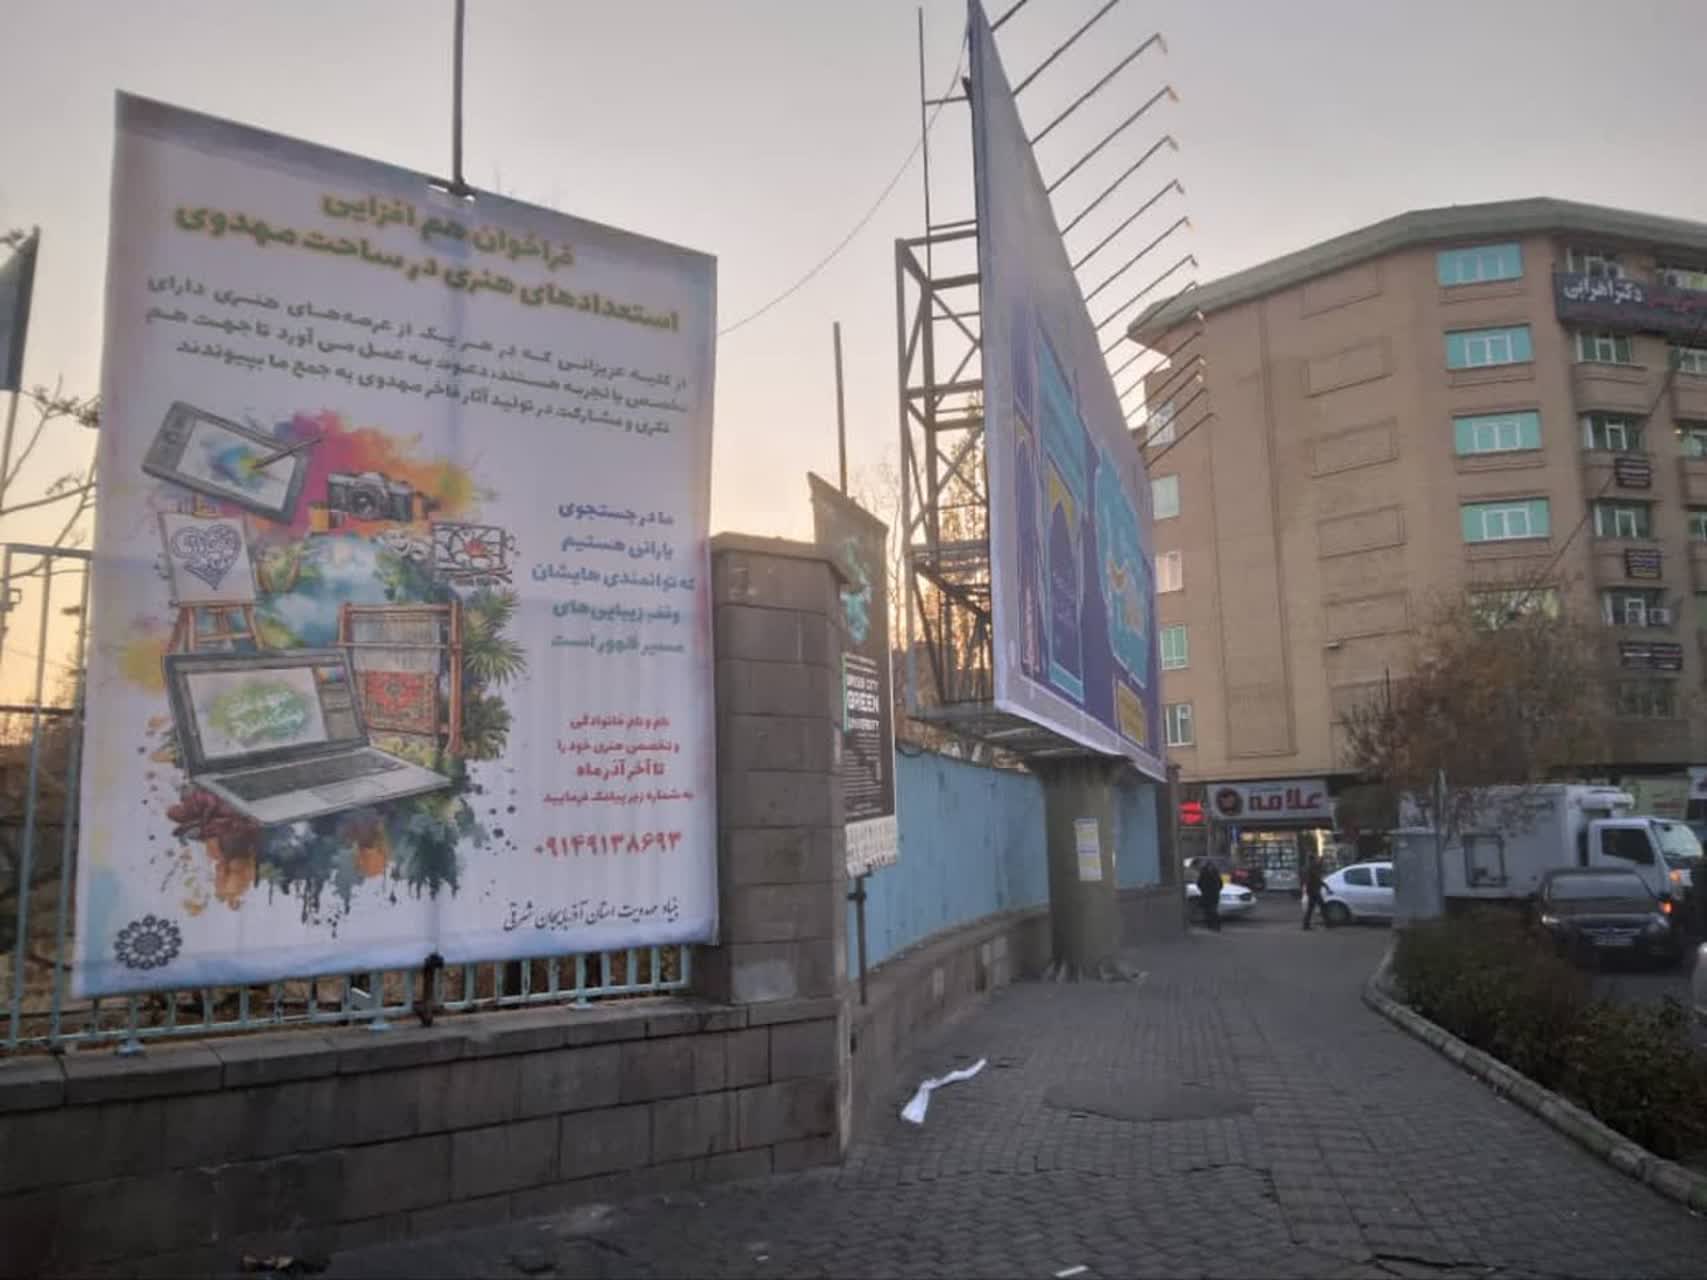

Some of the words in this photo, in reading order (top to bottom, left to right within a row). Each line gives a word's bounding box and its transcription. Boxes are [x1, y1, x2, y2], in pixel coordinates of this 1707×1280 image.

[321, 194, 416, 226] افزایی
[175, 207, 298, 248] مهدوی
[421, 216, 468, 242] هم
[302, 231, 404, 269] ساحت
[473, 225, 576, 272] فراخوان
[406, 257, 438, 282] در
[148, 275, 205, 297] دارای
[444, 269, 515, 296] هنری
[213, 290, 280, 310] هنری
[519, 283, 679, 332] استعدادهای
[146, 307, 188, 324] هم
[192, 314, 251, 335] جهت
[256, 320, 270, 337] تا
[276, 326, 314, 348] آورد
[396, 322, 412, 338] از
[317, 339, 354, 353] می
[358, 342, 403, 361] عمل
[498, 345, 516, 359] در
[522, 347, 552, 363] که
[269, 353, 289, 369] ما
[292, 360, 329, 379] جمع
[408, 353, 433, 371] به
[335, 367, 353, 384] به
[358, 373, 422, 393] مهدوی
[424, 383, 461, 399] فاخر
[461, 387, 489, 406] آثار
[491, 395, 534, 414] تولید
[535, 404, 553, 419] در
[556, 406, 623, 427] مشارکت
[559, 502, 637, 525] جستجوی
[639, 511, 655, 527] در
[658, 511, 675, 525] ما
[561, 534, 626, 552] هستیم
[628, 539, 673, 561] یارانی
[603, 570, 677, 593] توانمندی
[679, 576, 695, 591] که
[551, 634, 595, 648] است
[569, 713, 625, 731] خانوادگی
[569, 741, 590, 755] خود
[593, 741, 624, 755] هنری
[575, 762, 602, 776] ماه
[603, 758, 626, 781] آذر
[627, 758, 651, 781] آخر
[653, 761, 665, 776] تا
[646, 788, 682, 804] شماره
[1248, 787, 1324, 812] علامه
[503, 900, 533, 931] شرقی
